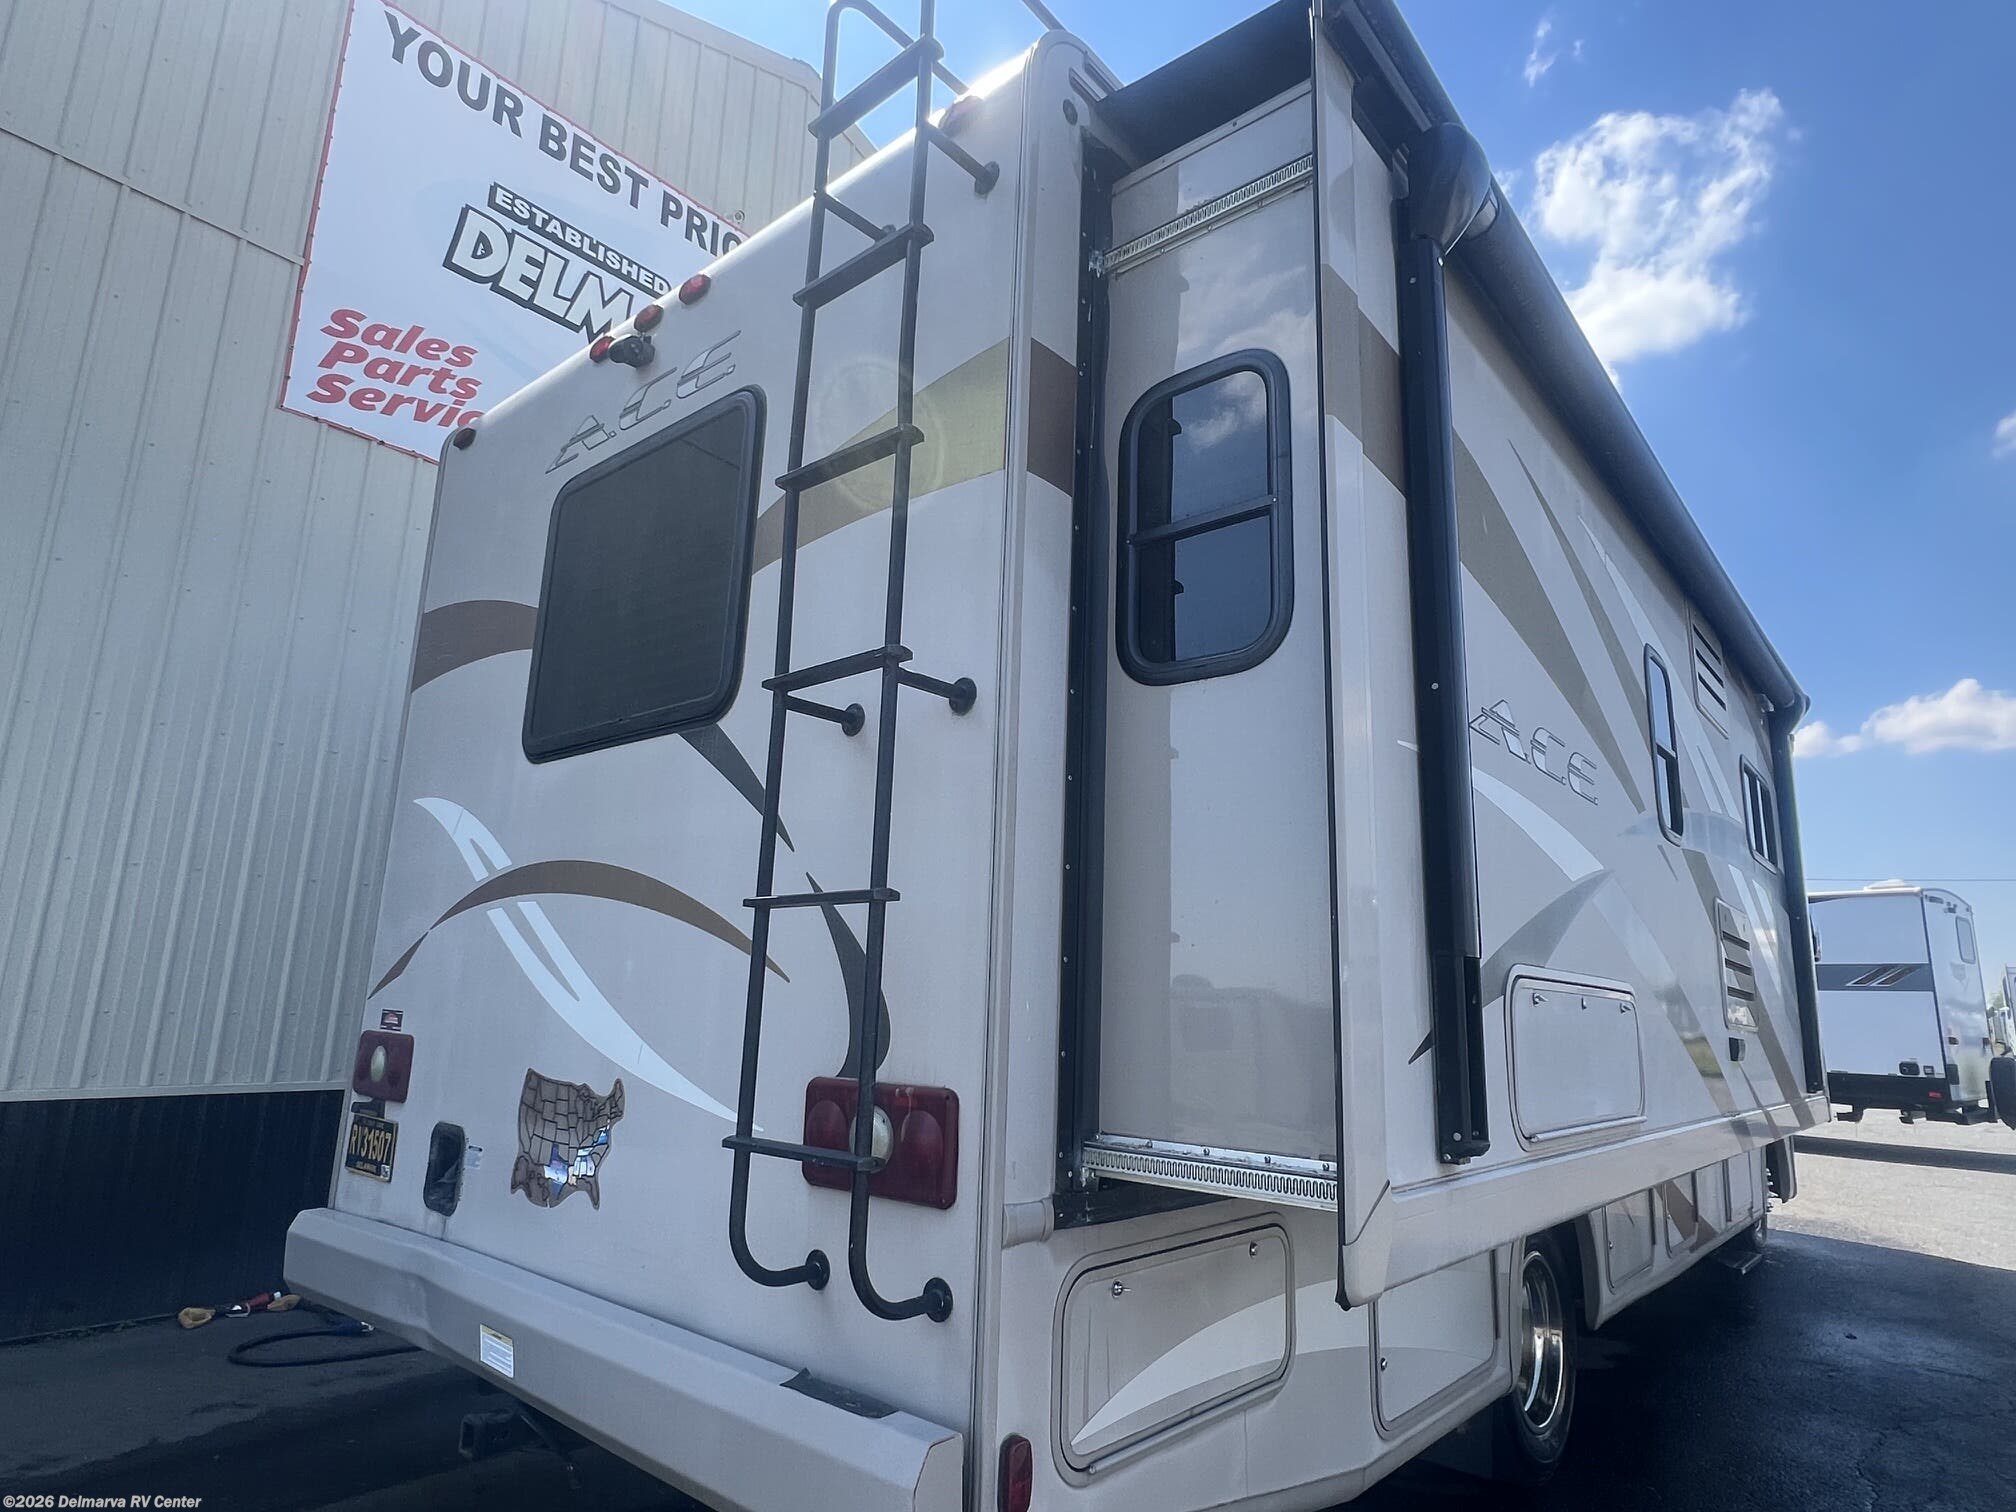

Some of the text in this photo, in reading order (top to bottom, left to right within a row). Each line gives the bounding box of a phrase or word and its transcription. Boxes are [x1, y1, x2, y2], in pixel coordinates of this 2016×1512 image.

[383, 10, 524, 138] YOUR
[538, 112, 650, 208] BEST
[495, 188, 669, 296] ESTABLISHED
[318, 343, 482, 400] Parts
[320, 308, 479, 368] Sales
